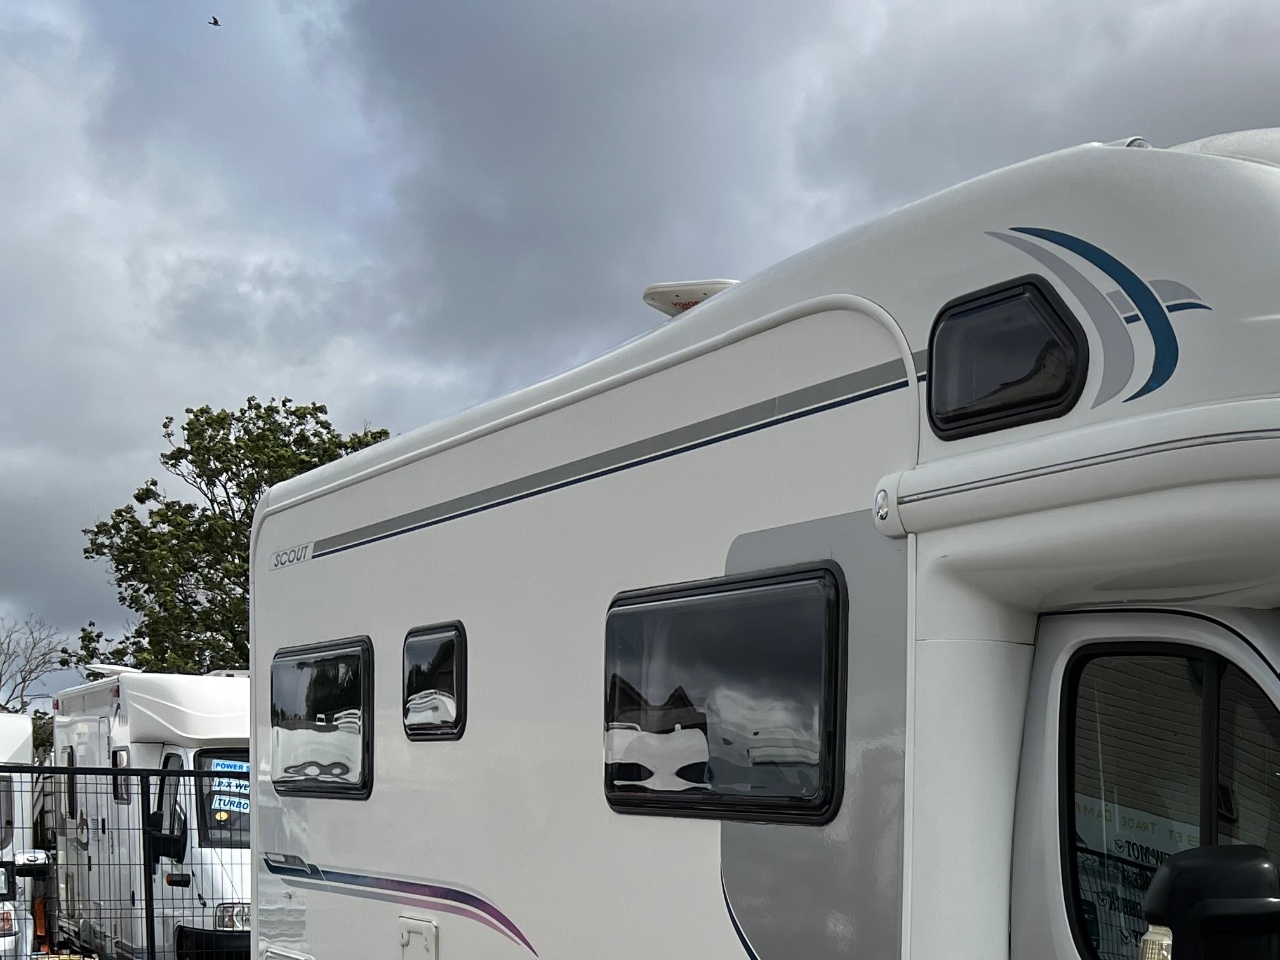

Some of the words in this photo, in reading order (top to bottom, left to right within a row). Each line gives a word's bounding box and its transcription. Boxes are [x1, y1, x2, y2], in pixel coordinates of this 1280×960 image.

[274, 545, 309, 568] SCOUT
[215, 762, 244, 770] POWER
[217, 798, 249, 810] TURBO
